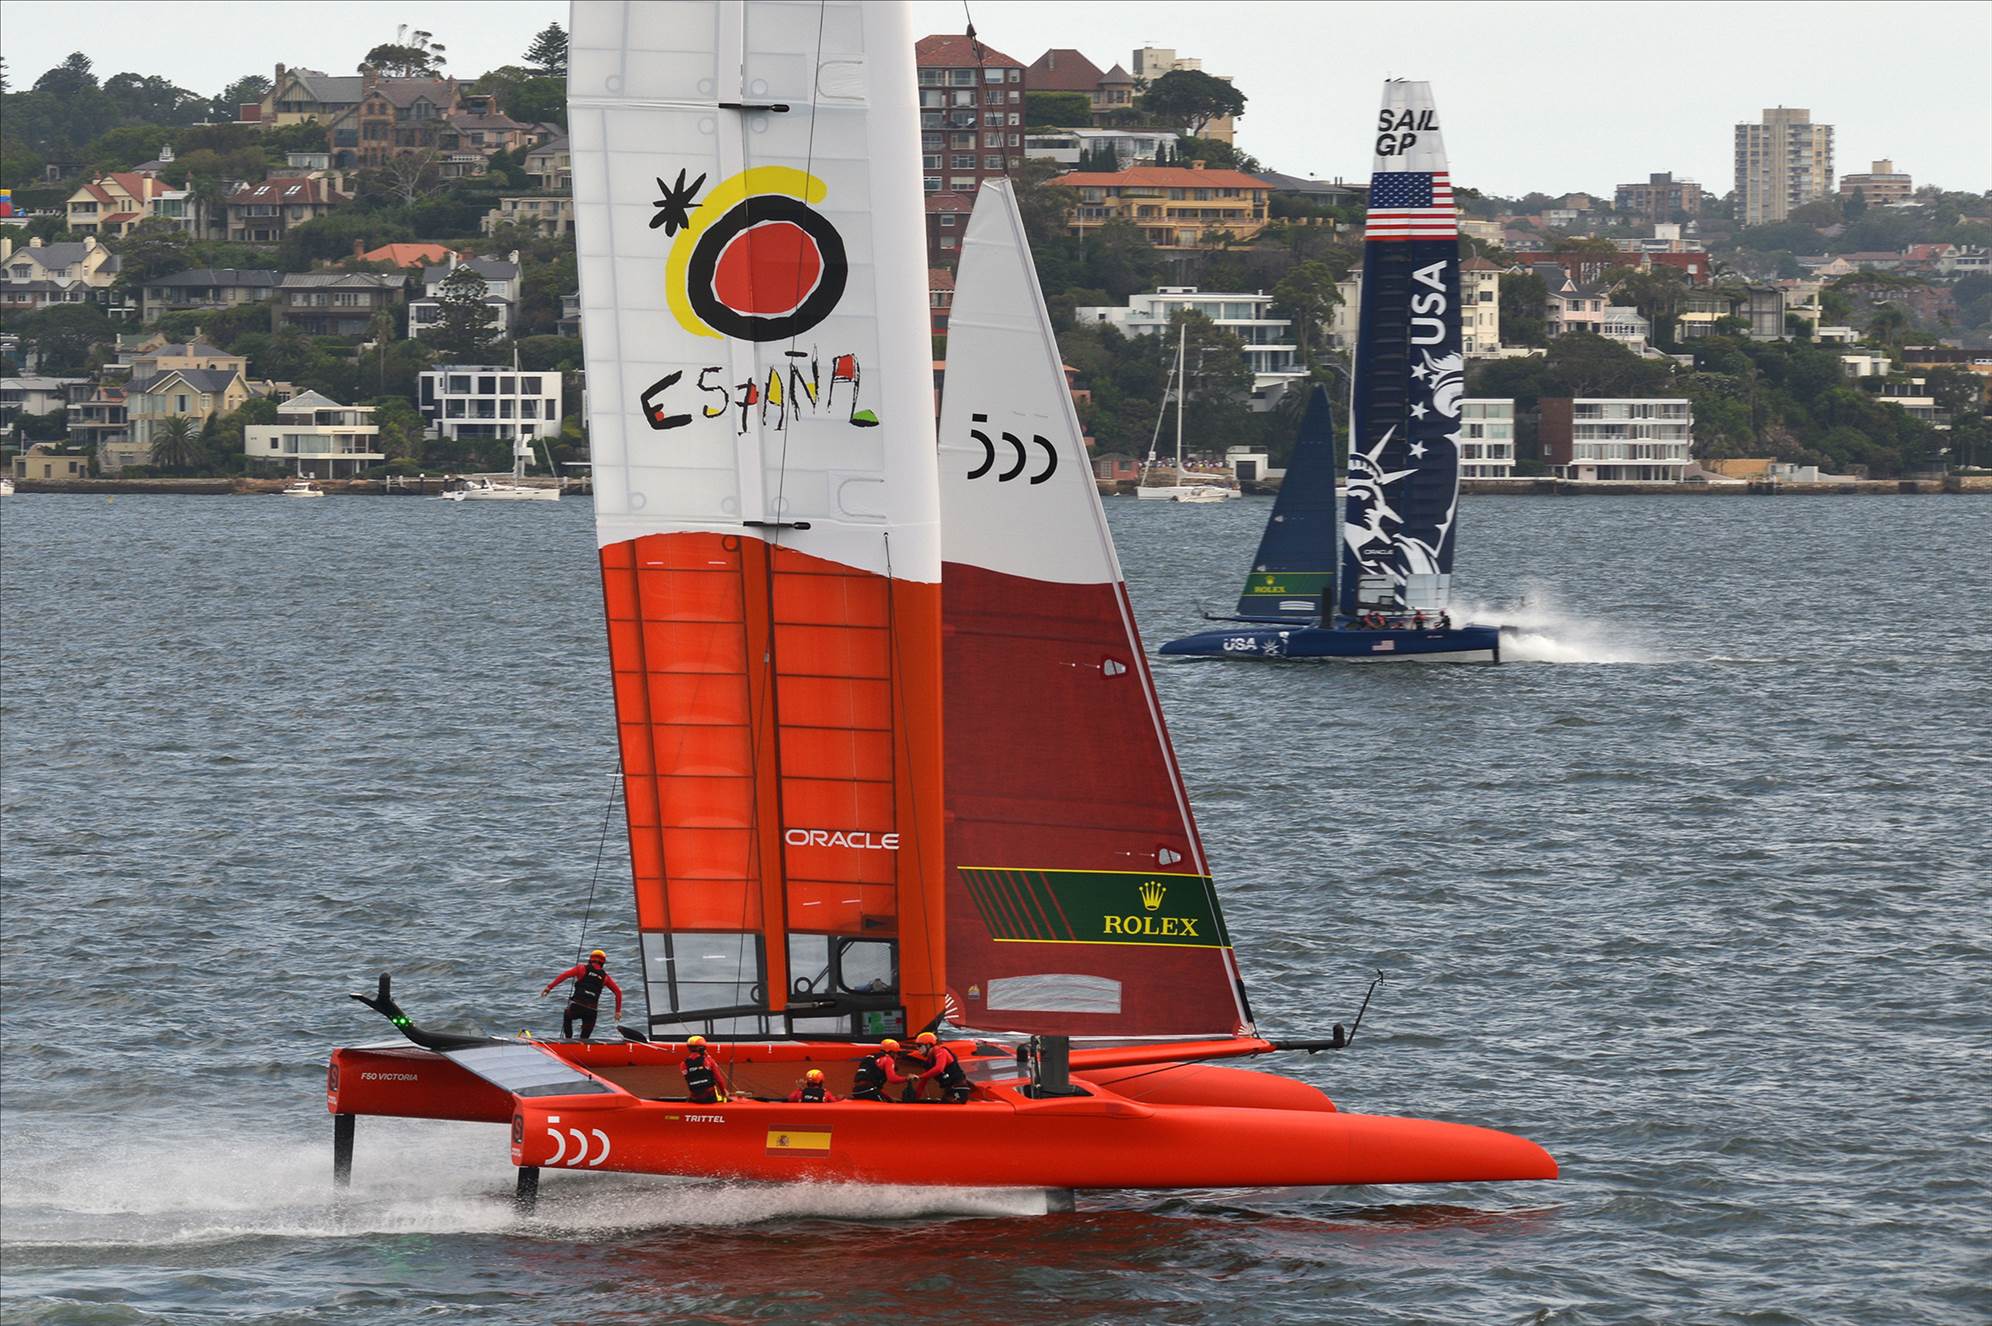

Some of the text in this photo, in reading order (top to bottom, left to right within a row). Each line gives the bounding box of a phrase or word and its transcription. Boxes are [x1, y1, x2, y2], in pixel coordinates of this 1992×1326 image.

[1378, 109, 1439, 132] SAIL
[1376, 133, 1416, 156] GP
[1411, 260, 1447, 344] USA
[640, 343, 880, 437] ESPAÑA
[1223, 637, 1258, 651] USA
[785, 829, 900, 850] ORACLE
[1103, 915, 1199, 937] ROLEX
[379, 1072, 418, 1081] VICTORIA
[684, 1114, 726, 1123] TRITTEL
